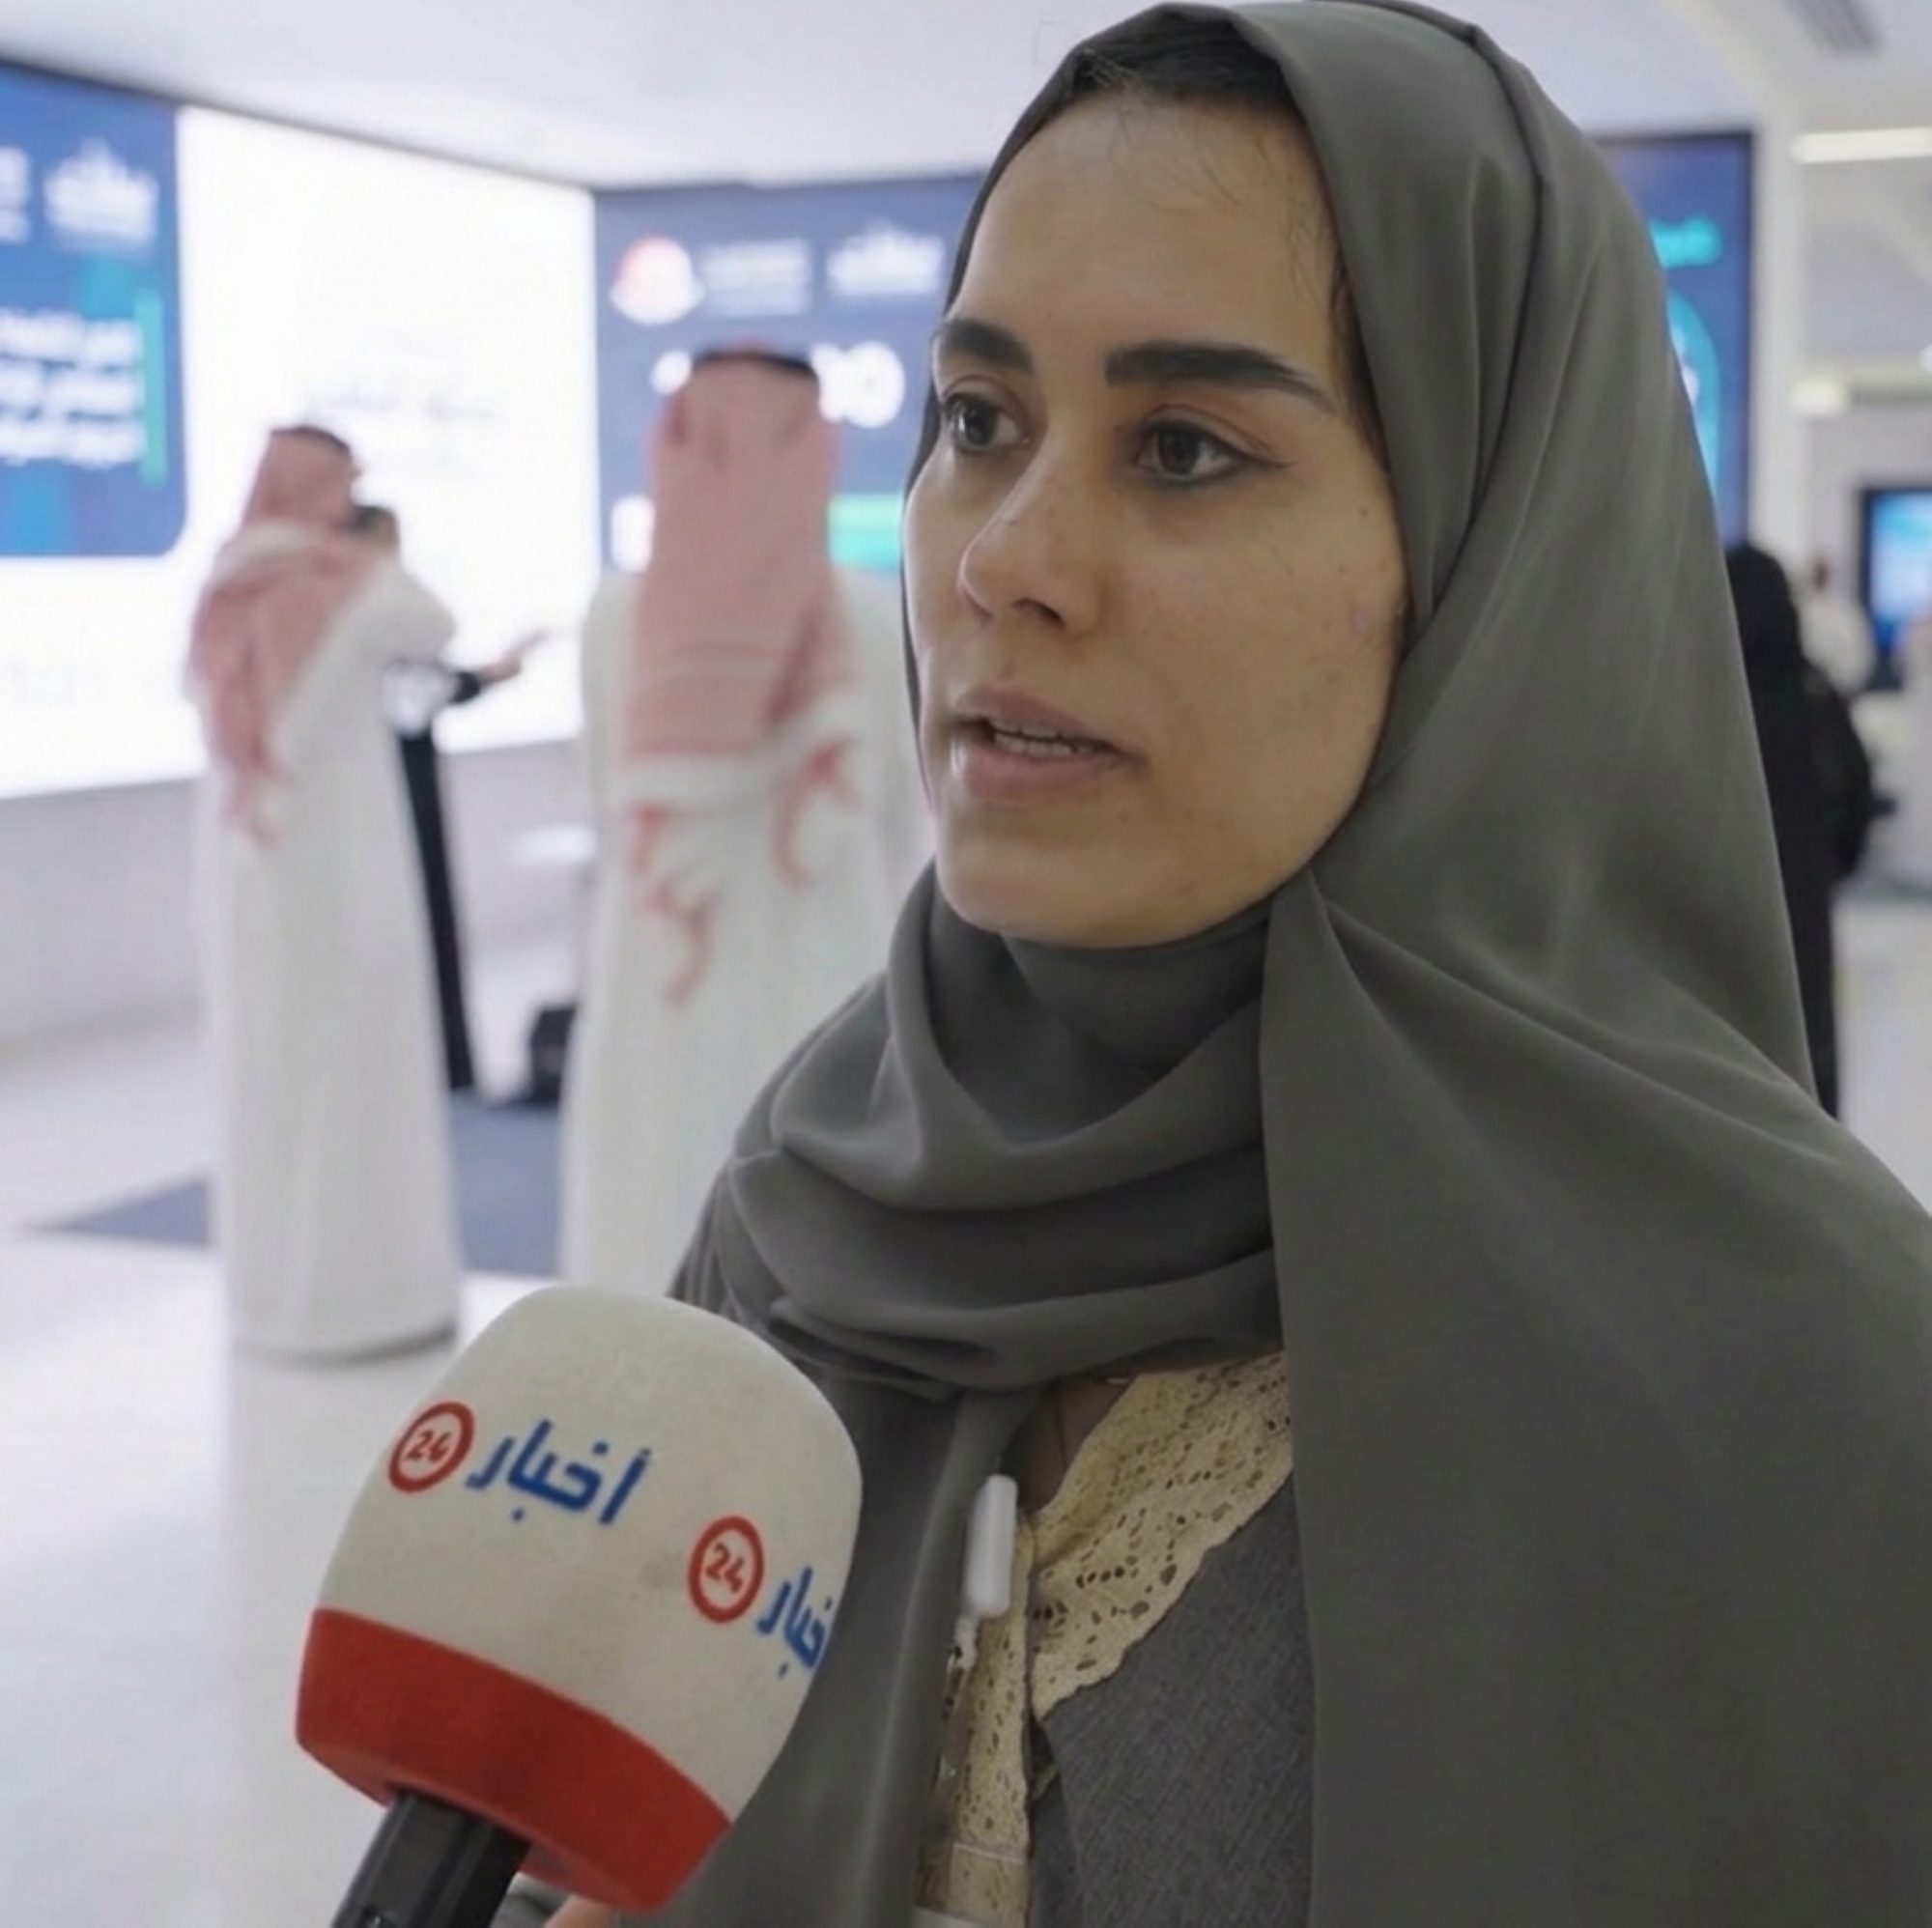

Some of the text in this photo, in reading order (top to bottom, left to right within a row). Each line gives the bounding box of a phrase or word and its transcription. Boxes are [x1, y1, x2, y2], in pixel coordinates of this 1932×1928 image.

[406, 1429, 451, 1463] 24
[705, 1543, 832, 1679] خبار 24
